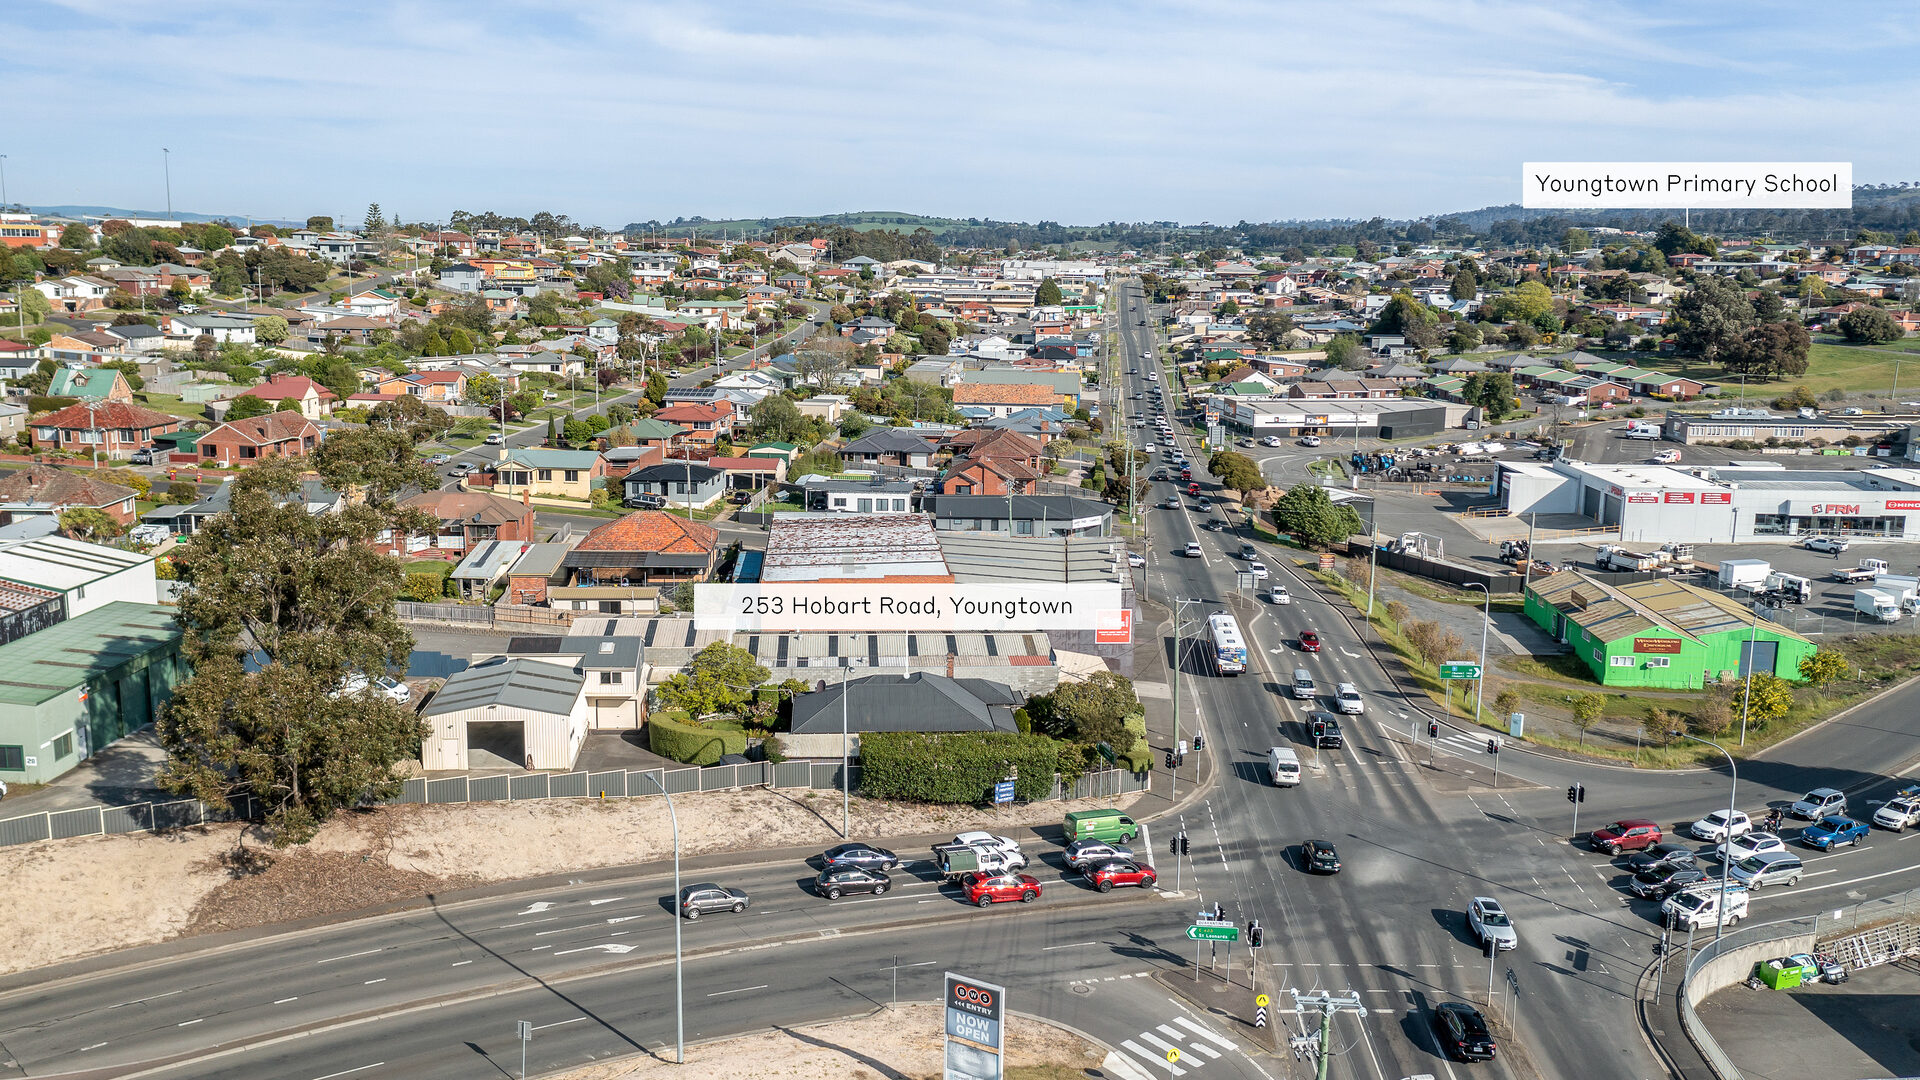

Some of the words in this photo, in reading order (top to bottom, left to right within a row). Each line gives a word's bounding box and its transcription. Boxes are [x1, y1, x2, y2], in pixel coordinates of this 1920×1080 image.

[1825, 504, 1860, 514] FRM
[966, 1002, 993, 1016] ENTRY
[956, 1012, 990, 1032] NOW
[956, 1024, 990, 1043] OPEN
